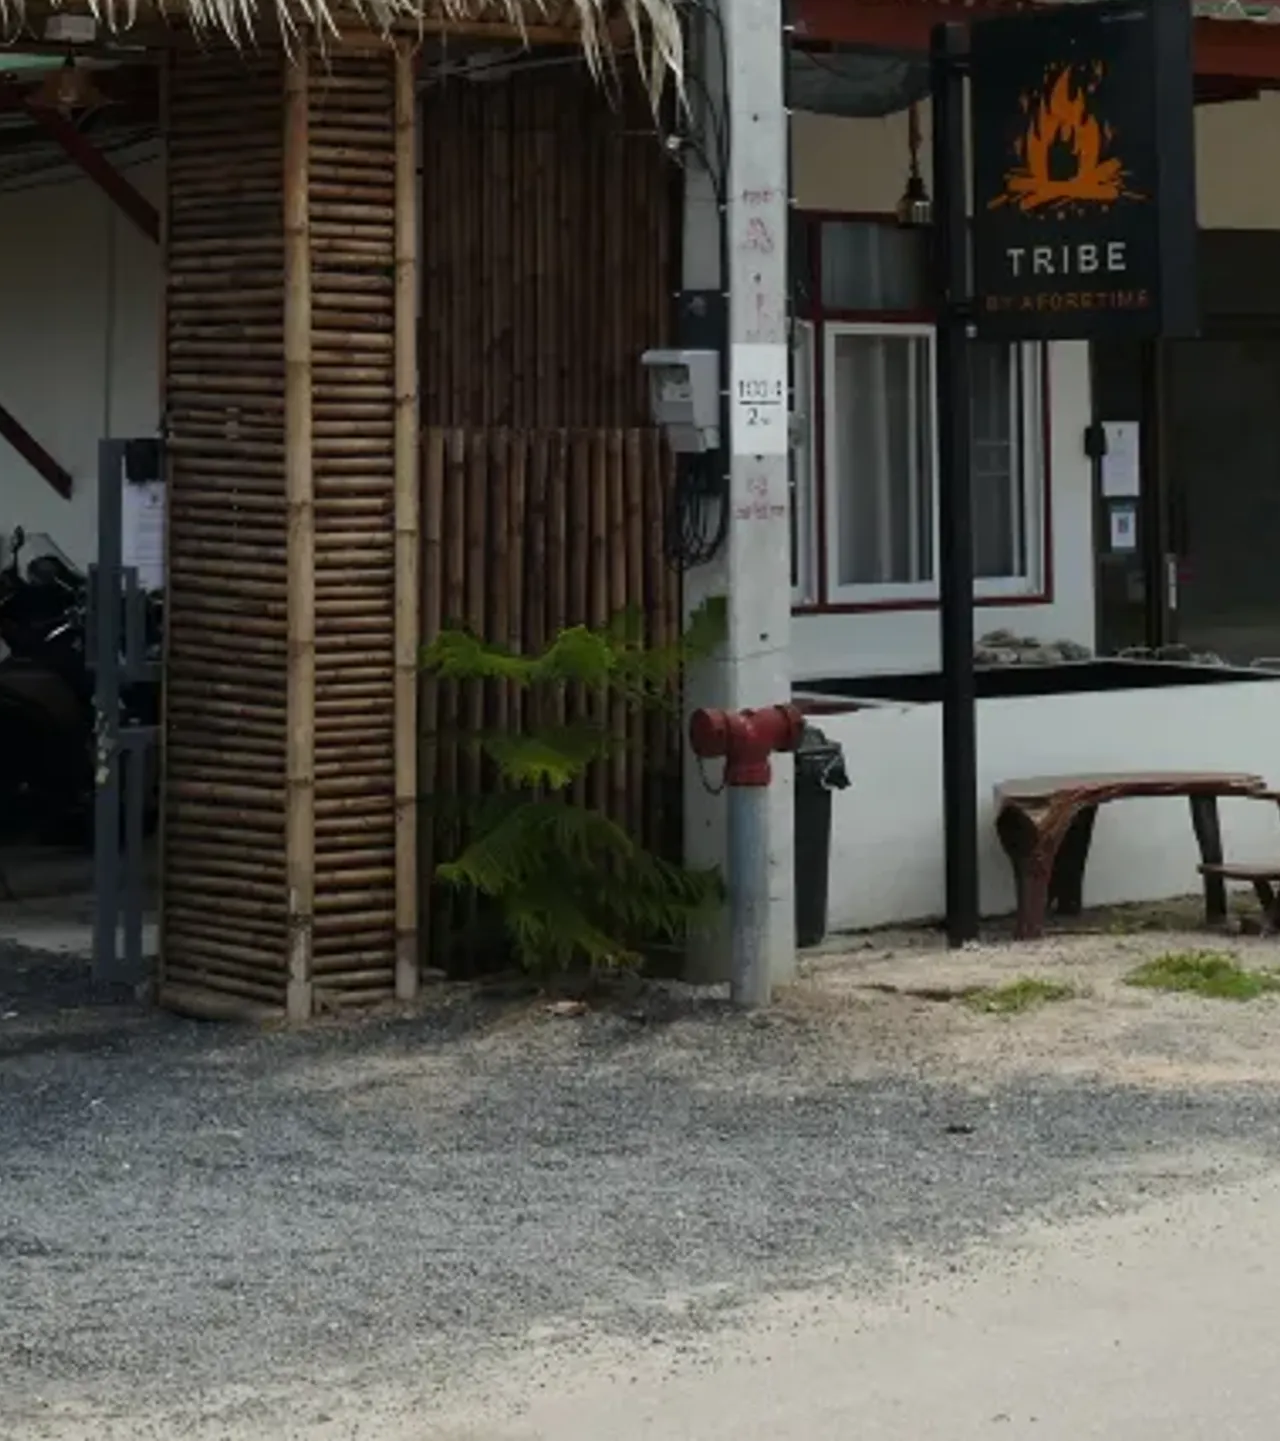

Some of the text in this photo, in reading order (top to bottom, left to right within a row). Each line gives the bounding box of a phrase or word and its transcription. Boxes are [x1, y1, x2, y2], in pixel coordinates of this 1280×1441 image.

[1006, 241, 1127, 277] TRIBE
[985, 288, 1150, 312] BY AFORETIME
